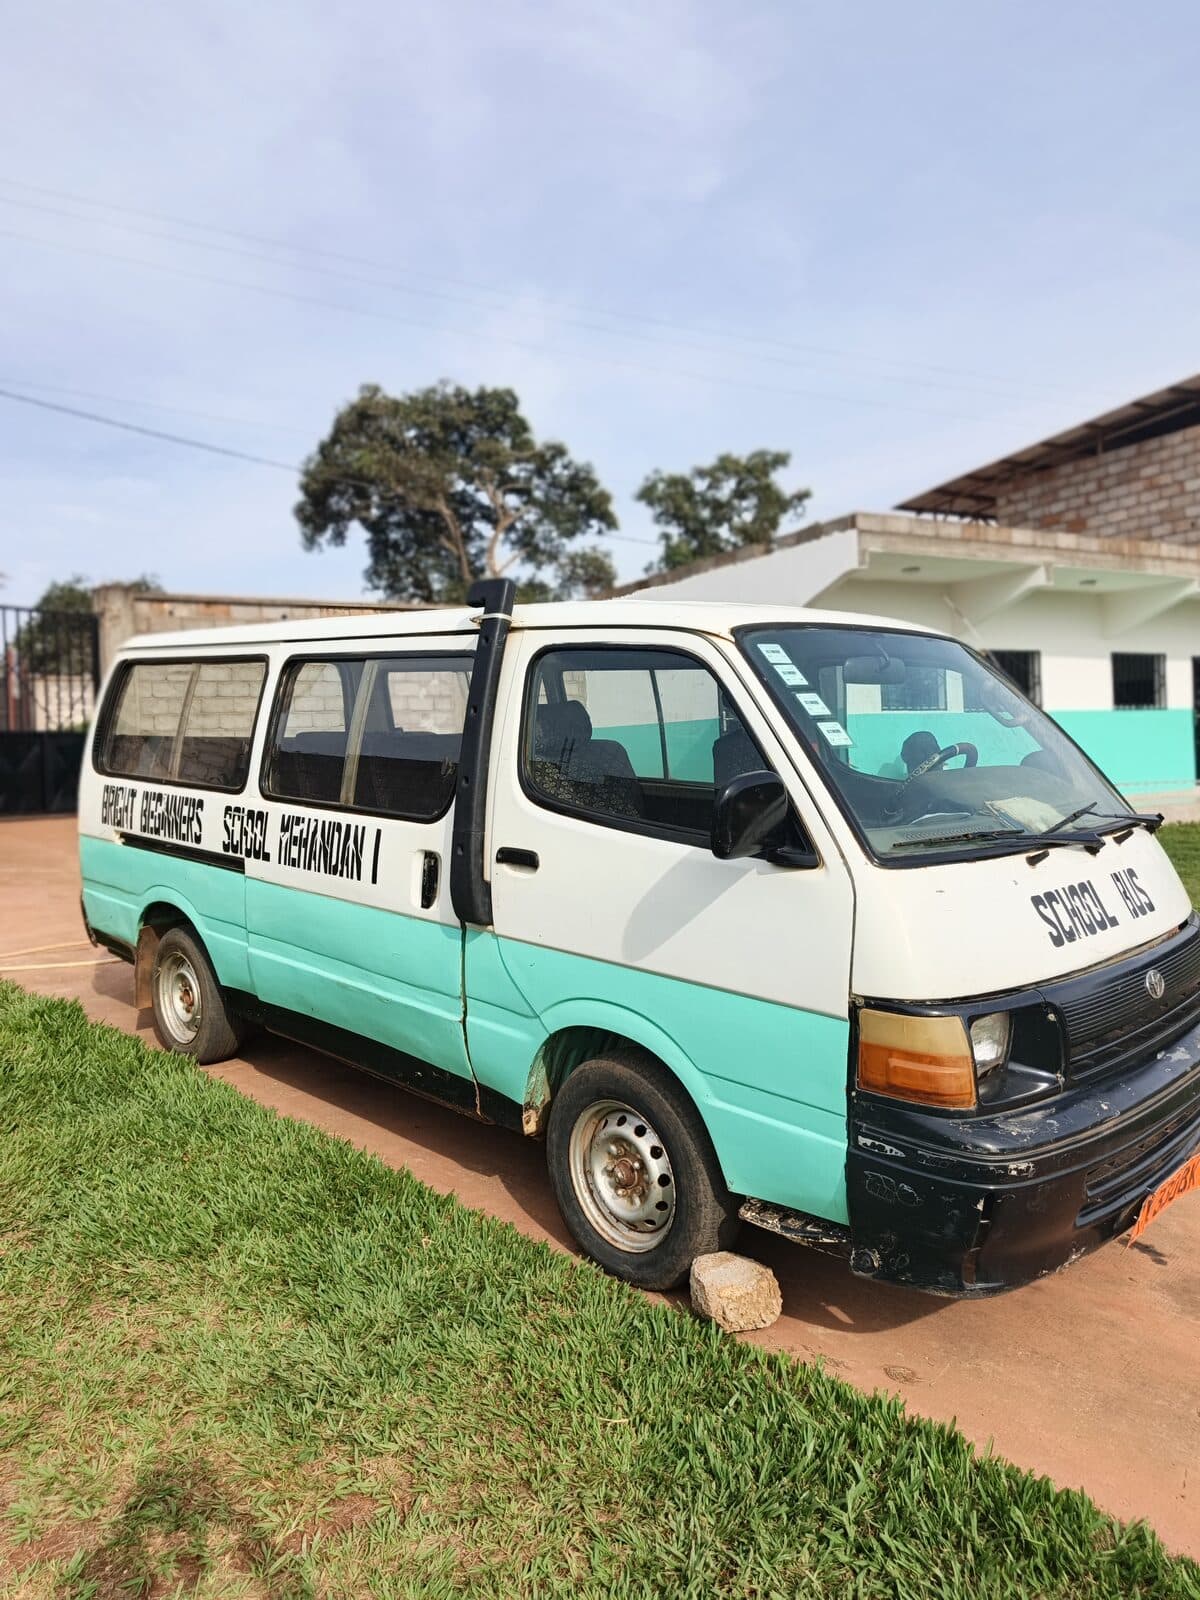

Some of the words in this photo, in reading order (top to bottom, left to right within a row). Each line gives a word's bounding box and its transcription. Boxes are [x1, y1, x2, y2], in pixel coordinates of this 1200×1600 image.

[101, 784, 137, 830] BRIGHT
[140, 790, 204, 845] BEGINNERS
[222, 805, 271, 862] SCHOOL
[1030, 879, 1120, 948] SCHOOL
[1110, 867, 1155, 919] BUS
